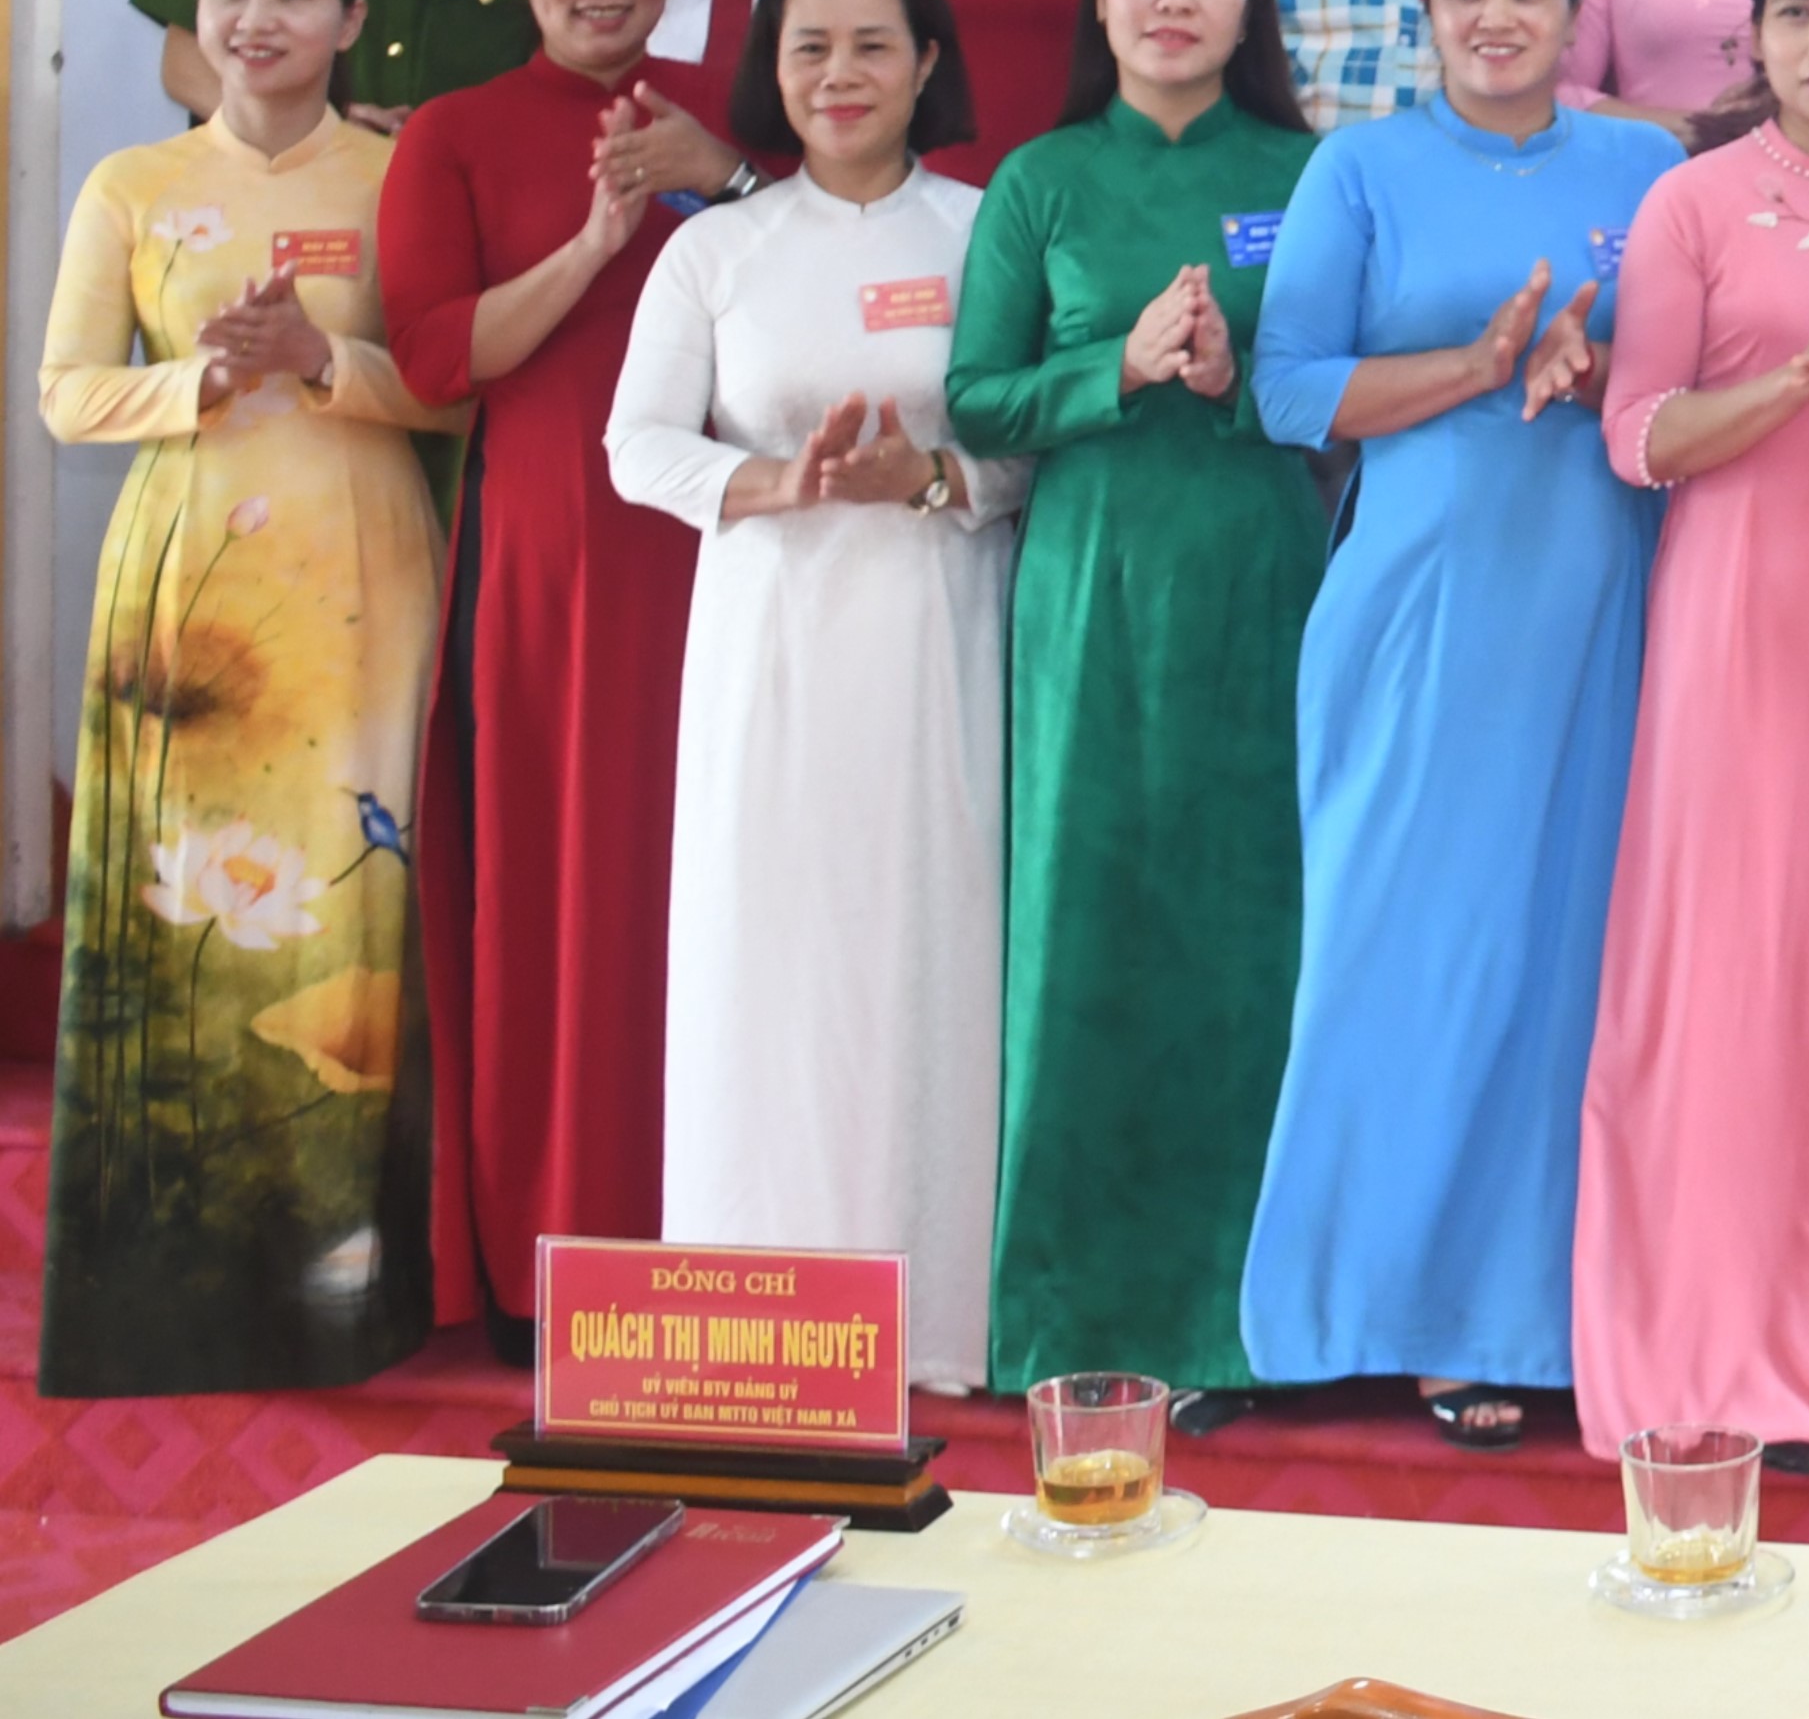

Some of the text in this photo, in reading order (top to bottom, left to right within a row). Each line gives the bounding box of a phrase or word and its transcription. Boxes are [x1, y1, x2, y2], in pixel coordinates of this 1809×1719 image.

[652, 1259, 796, 1296] ĐỒNG CHÍ
[571, 1304, 878, 1378] QUÁCH THỊ MINH NGUYỆT
[797, 1408, 833, 1427] NAM
